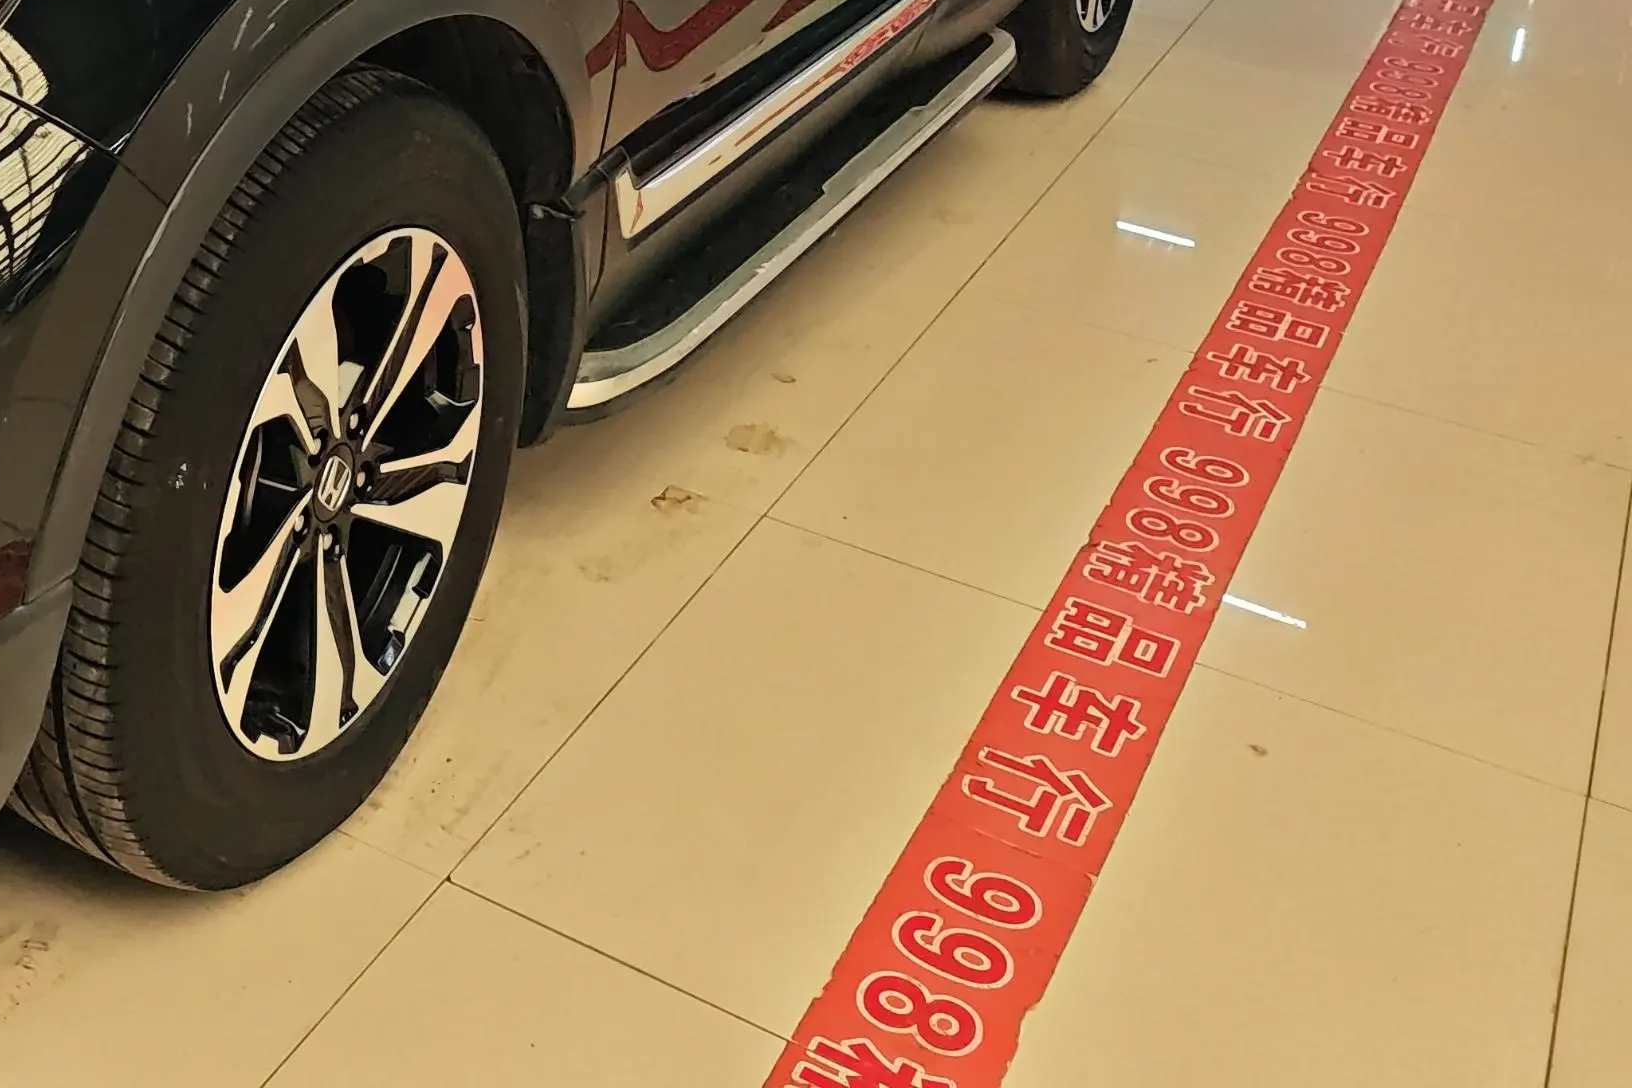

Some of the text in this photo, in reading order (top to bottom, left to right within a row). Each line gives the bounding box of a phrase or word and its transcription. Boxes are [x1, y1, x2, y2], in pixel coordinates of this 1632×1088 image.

[1178, 209, 1370, 443] 998精品车行
[960, 445, 1251, 848] 998精品车行
